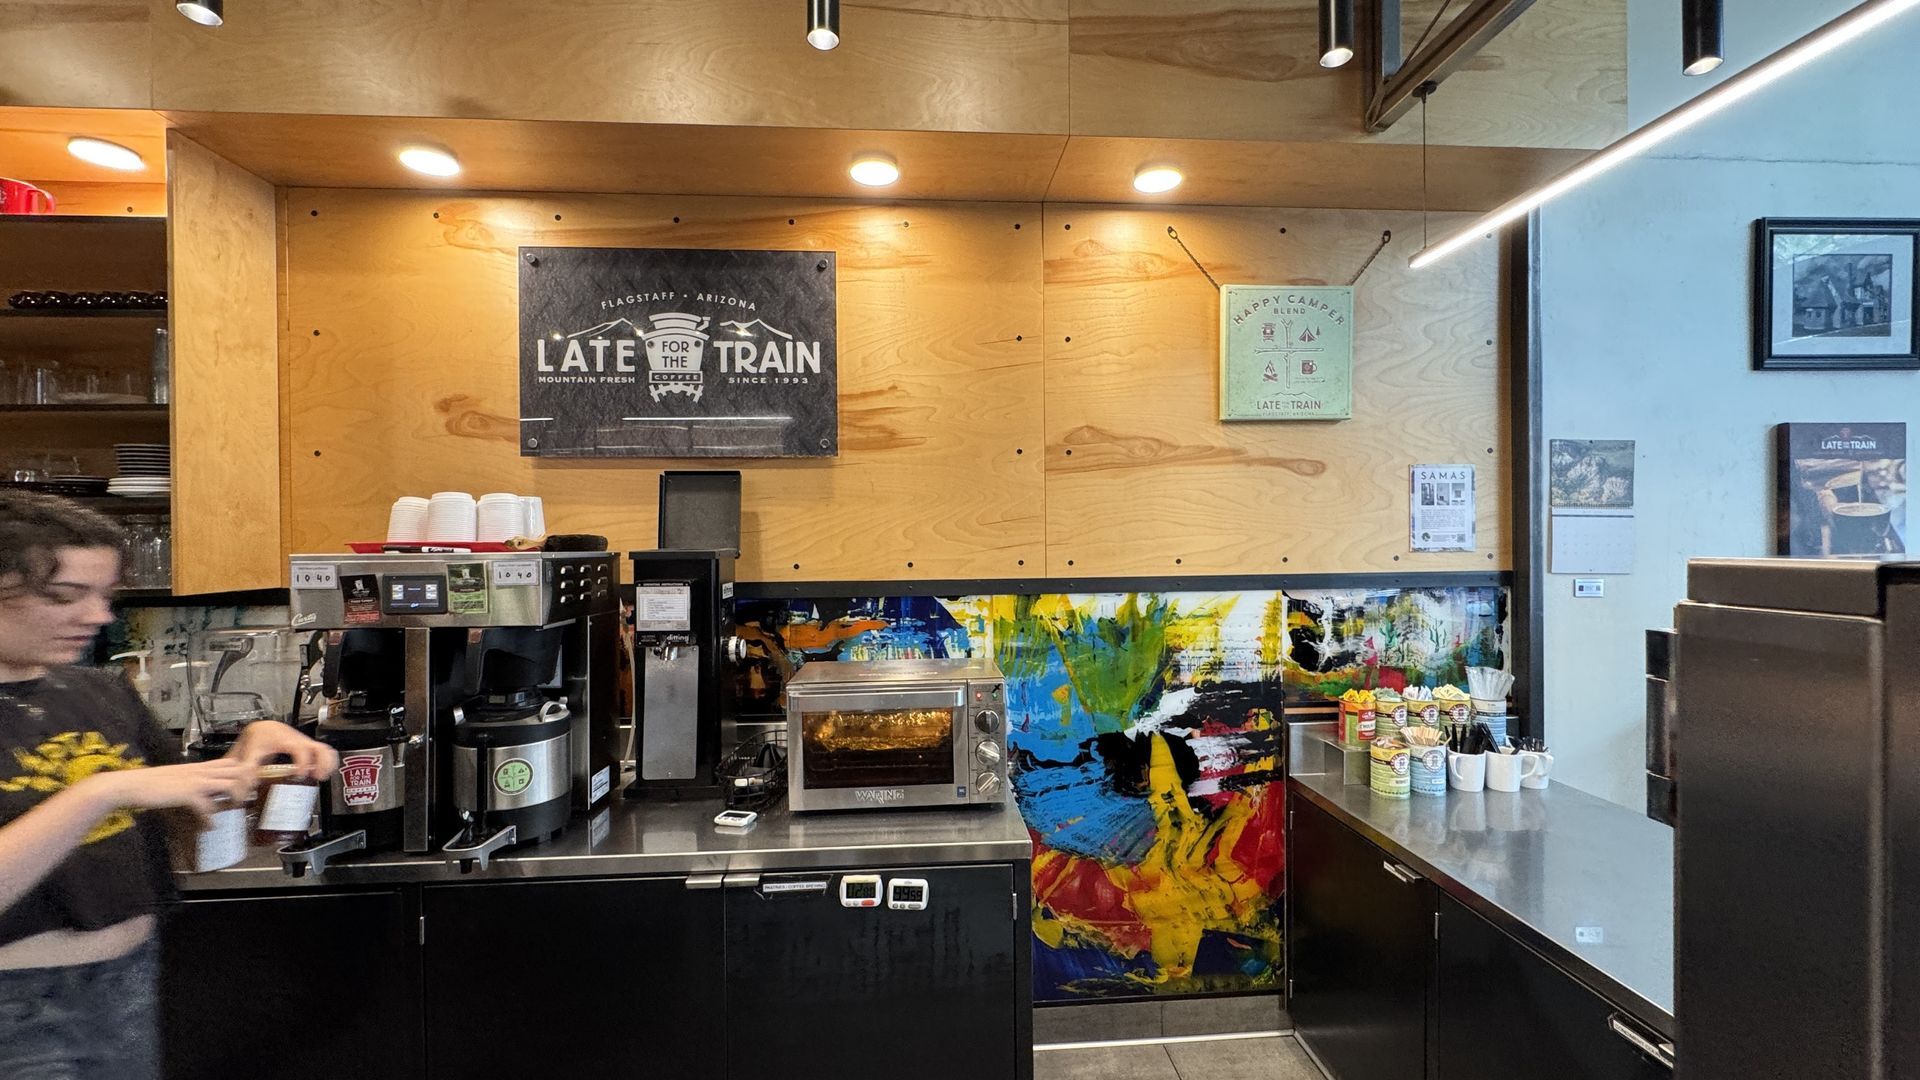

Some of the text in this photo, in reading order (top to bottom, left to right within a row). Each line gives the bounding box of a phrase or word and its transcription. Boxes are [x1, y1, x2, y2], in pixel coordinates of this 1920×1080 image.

[601, 292, 756, 311] FLAGSTAFF ARIZONA
[1233, 294, 1345, 325] HAPPY CAMPER
[662, 341, 690, 353] FOR
[537, 339, 635, 372] LATE
[713, 340, 820, 373] TRAIN
[662, 356, 688, 368] THE
[538, 376, 635, 384] MOUNTAIN FRESH
[1256, 400, 1281, 410] LATE
[1291, 400, 1321, 410] TRAIN
[1821, 440, 1843, 450] LATE
[1850, 440, 1877, 450] TRAIN
[1421, 471, 1466, 480] SAMAS
[350, 768, 371, 776] LATE
[854, 788, 905, 804] WARING
